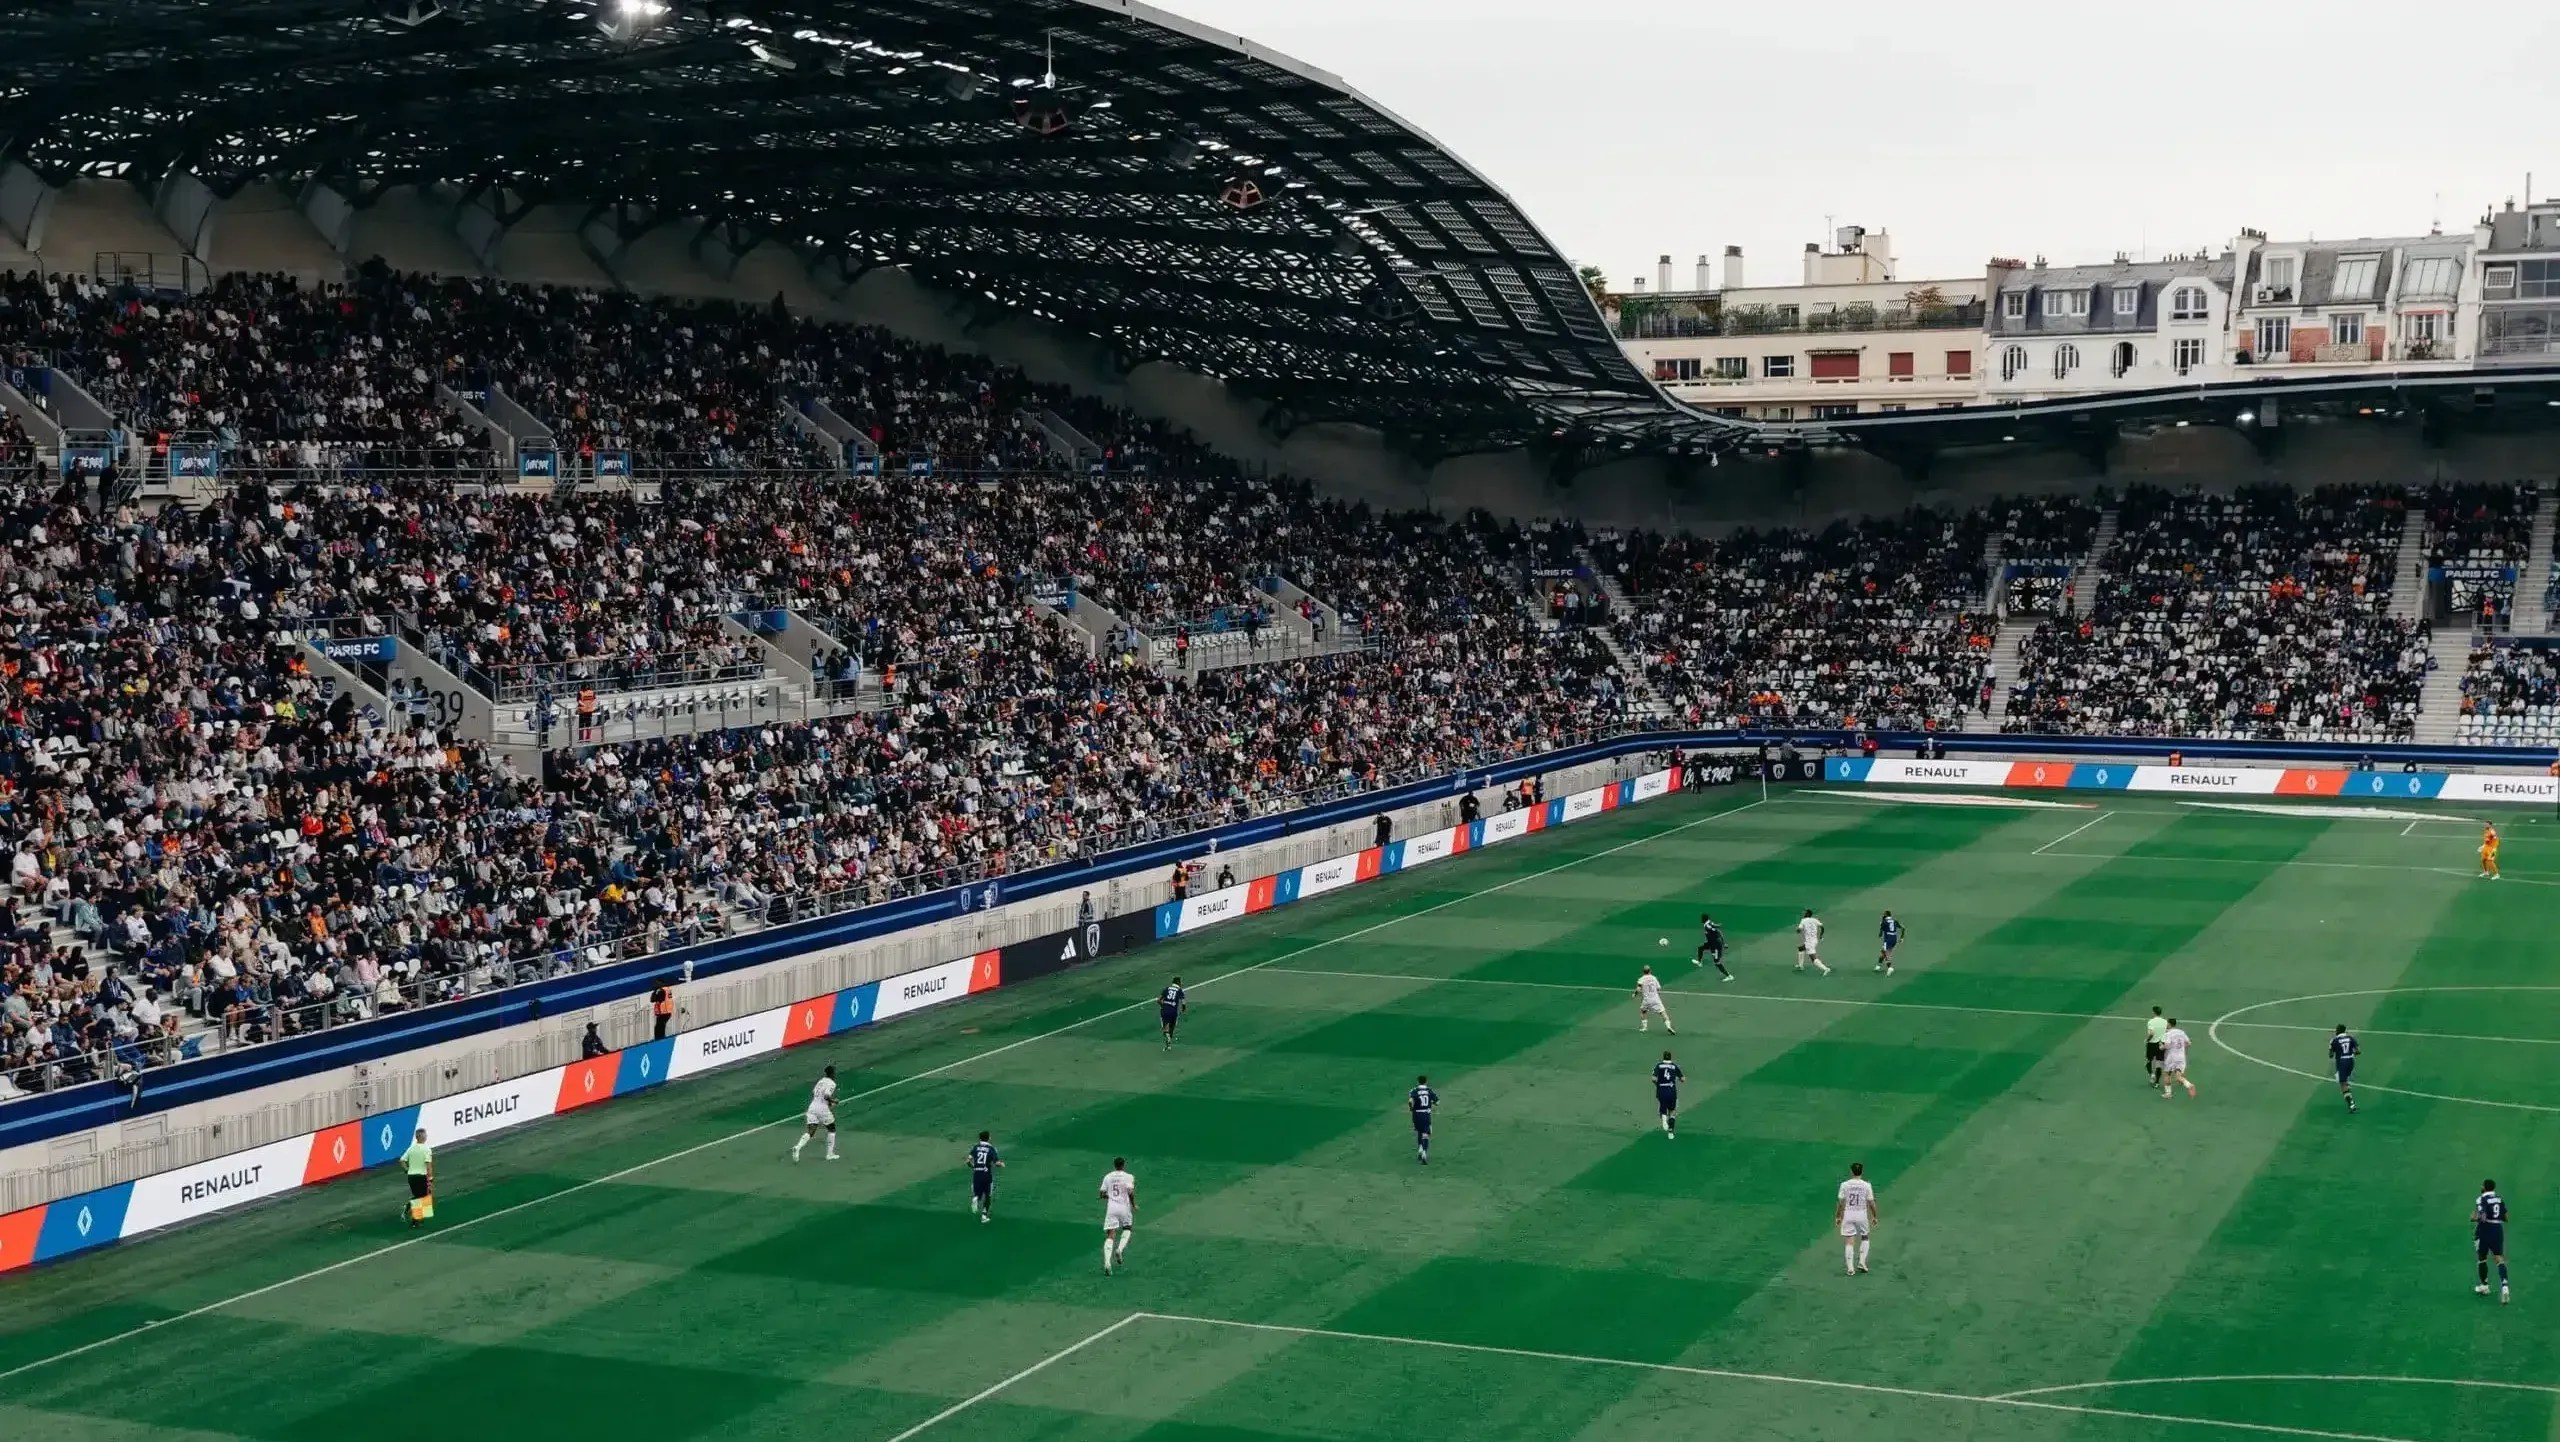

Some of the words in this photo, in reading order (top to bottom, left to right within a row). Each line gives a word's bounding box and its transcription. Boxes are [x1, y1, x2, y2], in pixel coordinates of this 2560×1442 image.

[2445, 570, 2481, 578] PARIS
[2483, 570, 2500, 578] FC
[325, 644, 362, 658] PARIS
[363, 643, 380, 655] FC
[430, 690, 463, 726] 39
[1905, 767, 1969, 778] RENAULT
[2171, 775, 2238, 786] RENAULT
[2484, 784, 2555, 795] RENAULT
[1418, 840, 1441, 854] RENAULT
[1316, 867, 1343, 884] RENAULT
[1198, 899, 1229, 917] RENAULT
[904, 977, 948, 1000] RENAULT
[703, 1029, 756, 1057] RENAULT
[454, 1094, 521, 1127] RENAULT
[977, 1152, 988, 1164] 21
[182, 1165, 263, 1204] RENAULT
[1112, 1184, 1120, 1197] 5
[1849, 1193, 1859, 1206] 21
[2493, 1204, 2500, 1218] 9
